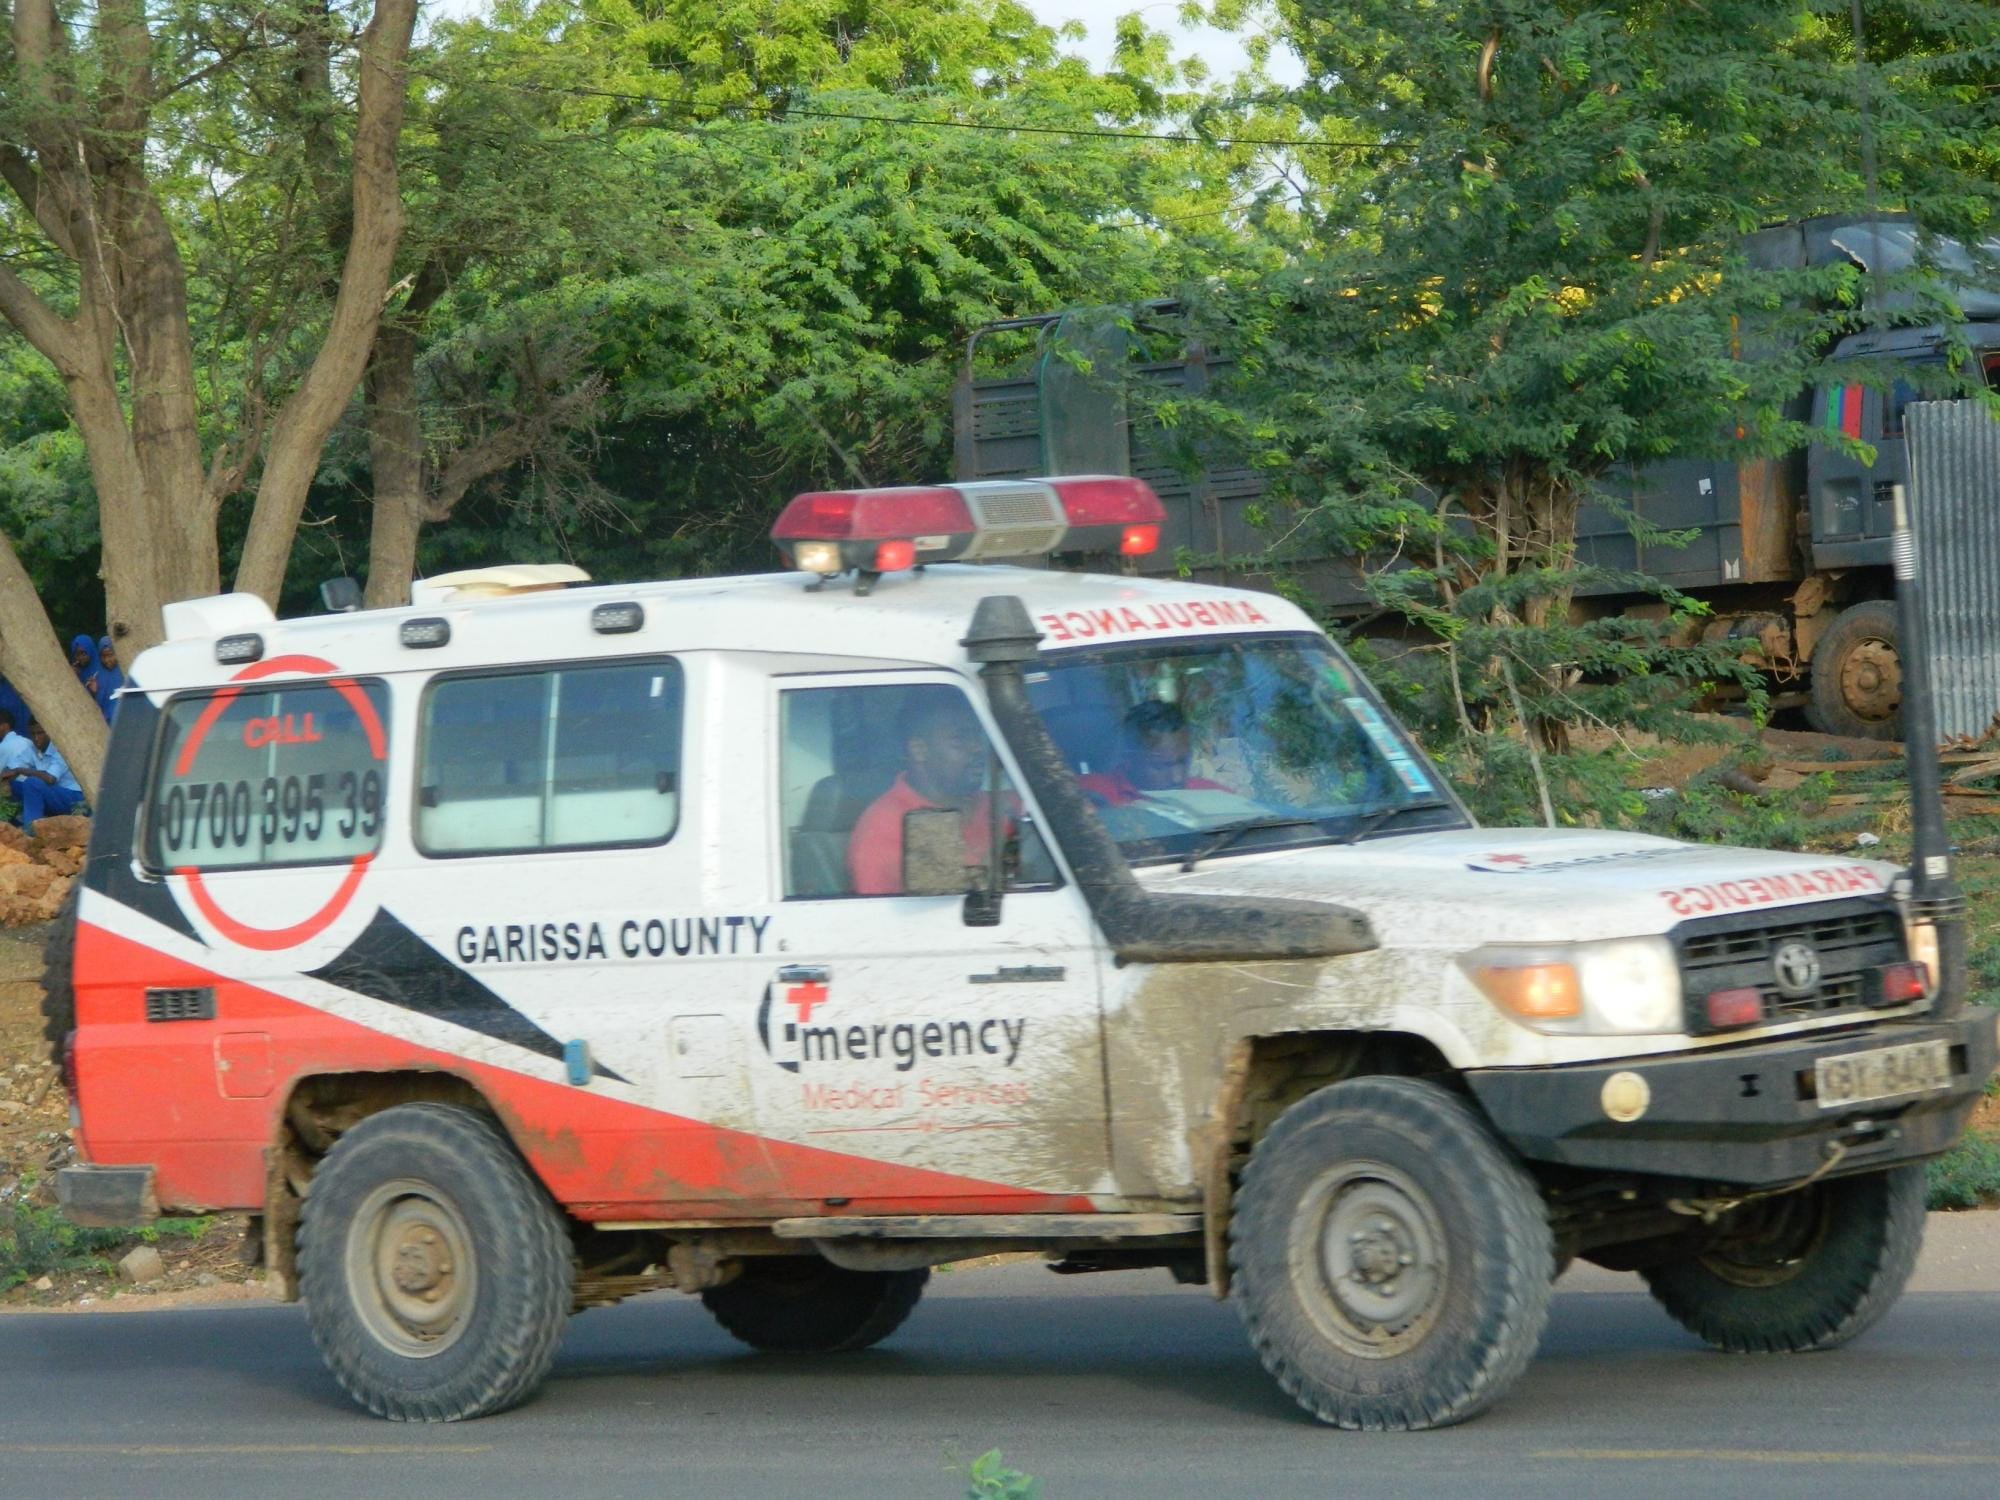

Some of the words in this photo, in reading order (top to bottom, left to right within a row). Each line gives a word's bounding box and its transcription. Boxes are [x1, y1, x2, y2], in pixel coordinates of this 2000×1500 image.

[243, 713, 322, 748] CALL
[166, 779, 250, 852] 0700
[456, 922, 608, 963] GARISSA
[620, 915, 771, 958] COUNTY
[802, 1080, 902, 1110] Medical
[918, 1078, 1033, 1107] Services
